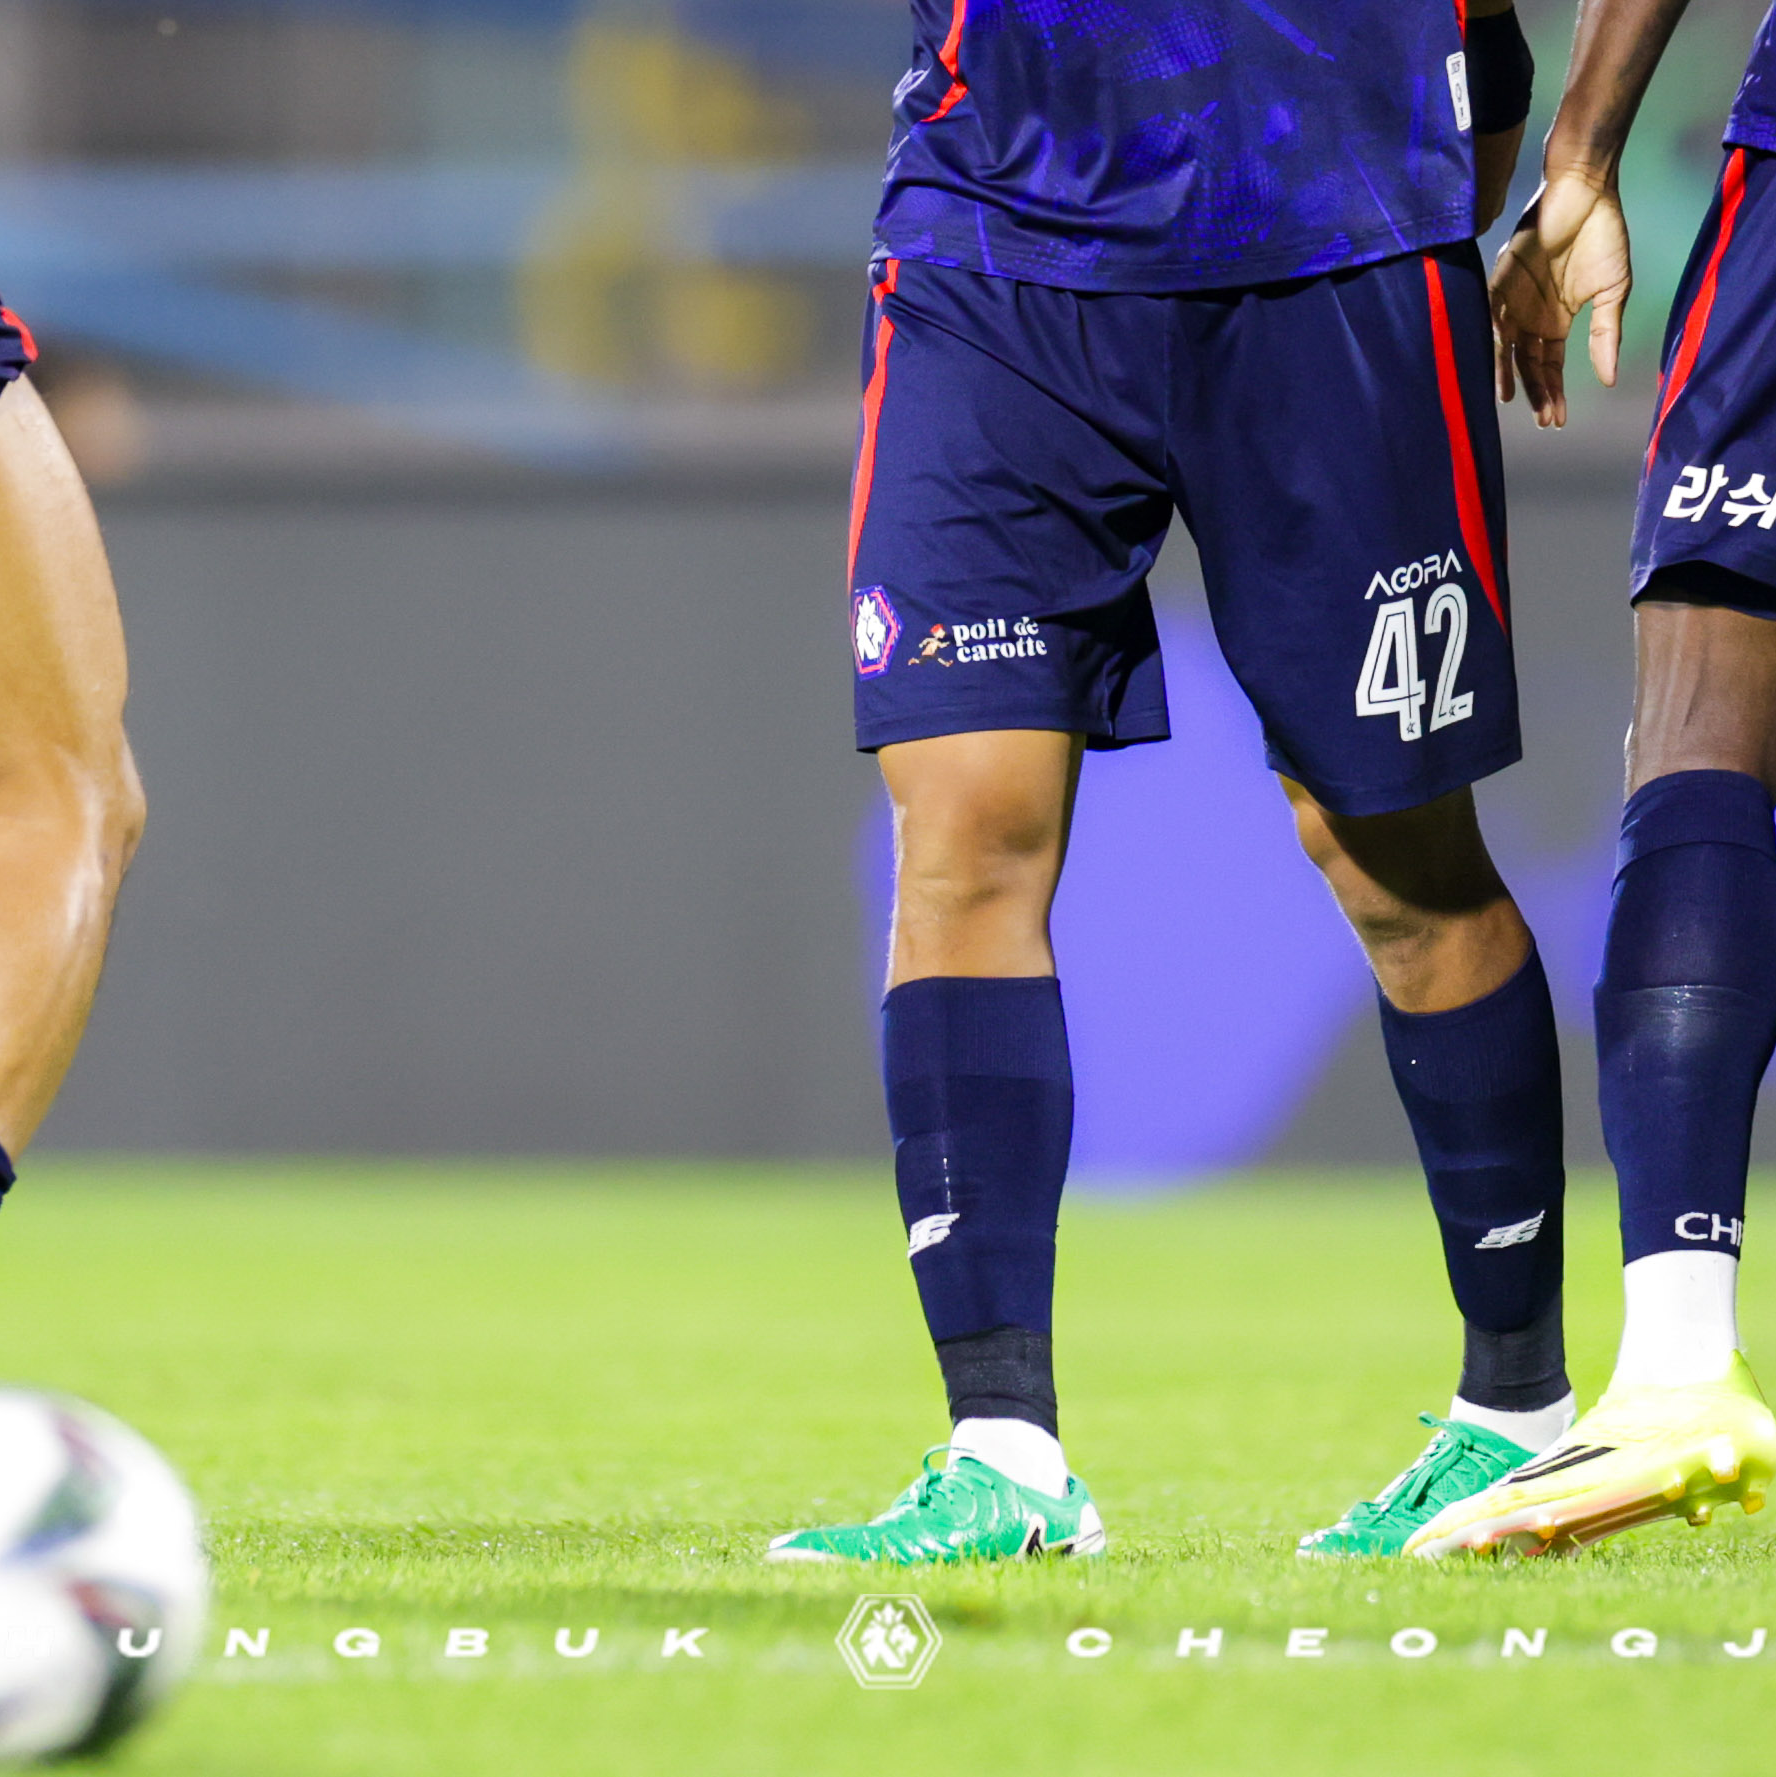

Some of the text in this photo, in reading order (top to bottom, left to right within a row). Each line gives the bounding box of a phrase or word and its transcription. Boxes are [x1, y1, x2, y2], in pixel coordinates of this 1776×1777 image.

[1364, 548, 1463, 600] AGORA
[952, 618, 1007, 647] poil
[956, 636, 1048, 663] carotte
[1355, 582, 1474, 742] 42
[1674, 1211, 1742, 1247] CH
